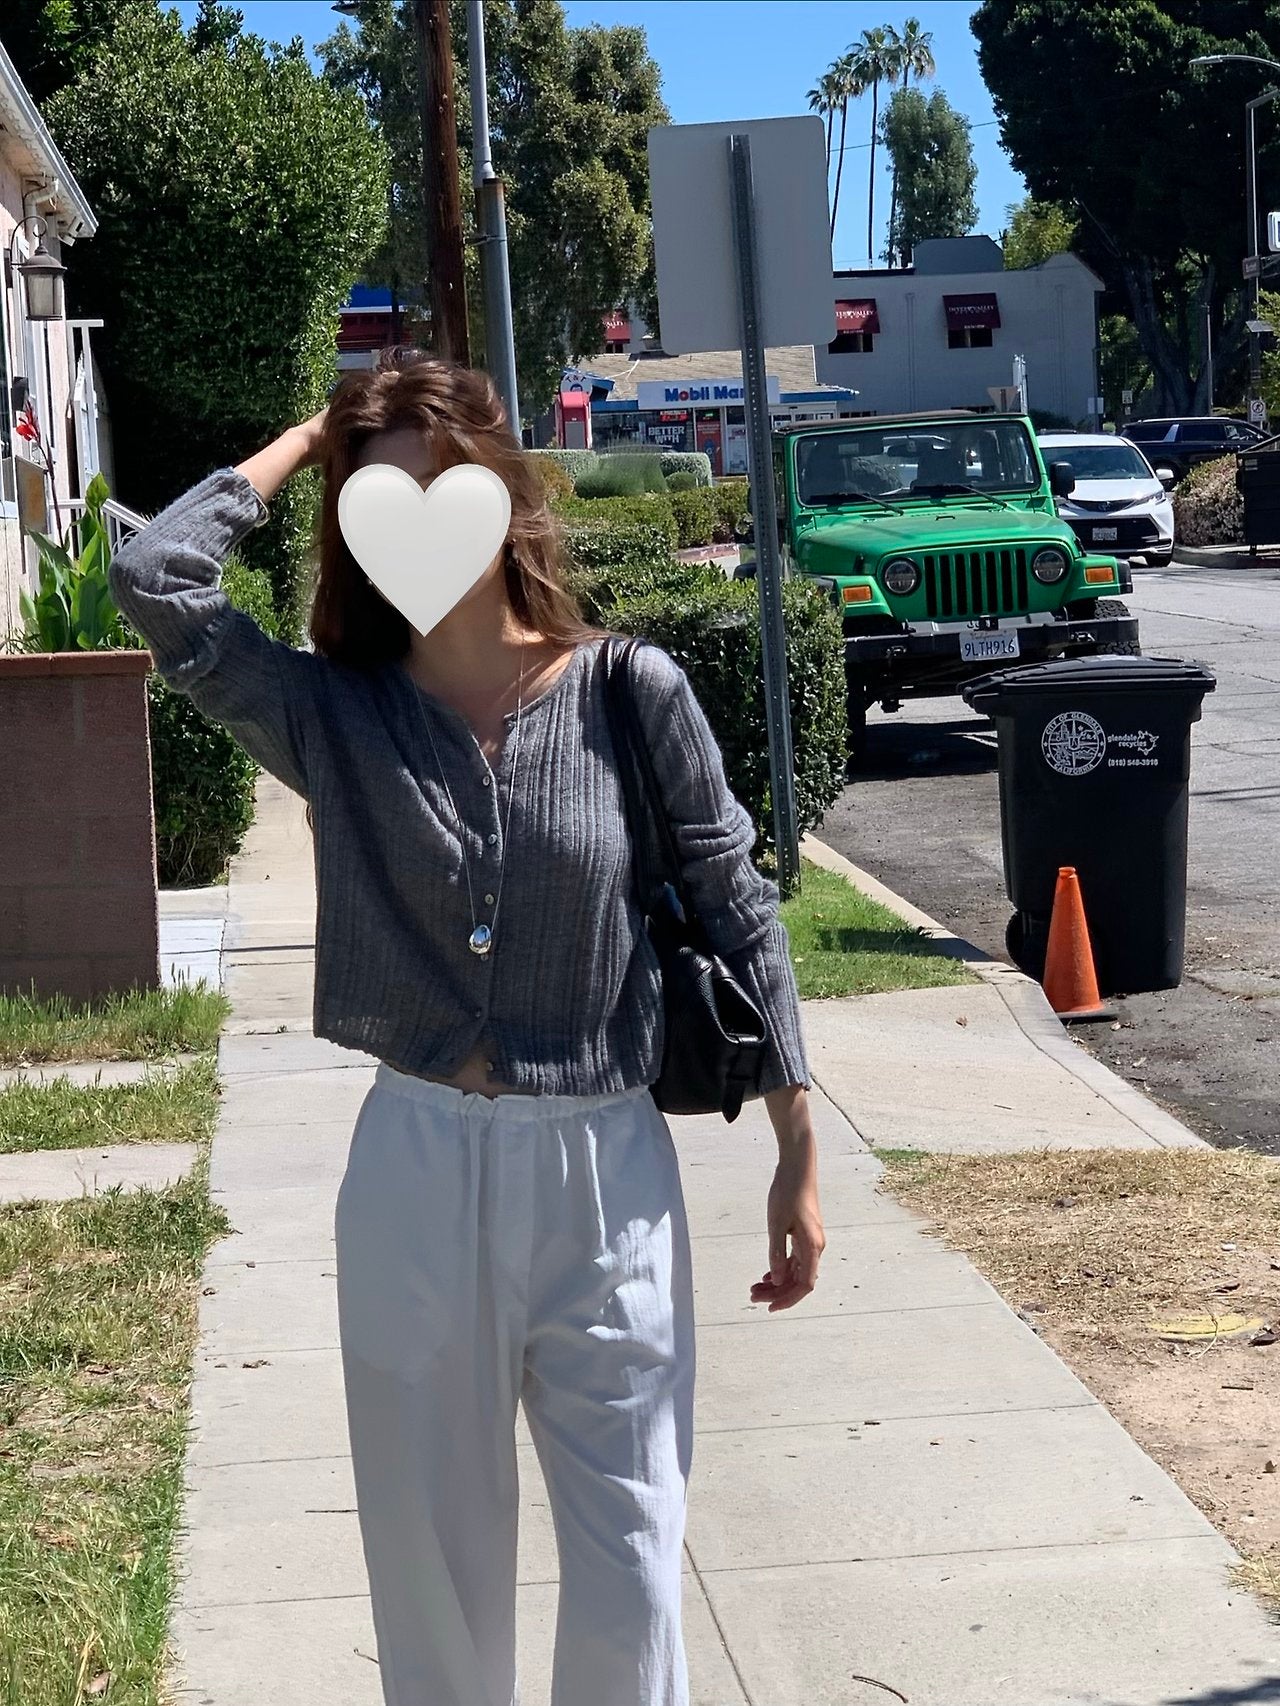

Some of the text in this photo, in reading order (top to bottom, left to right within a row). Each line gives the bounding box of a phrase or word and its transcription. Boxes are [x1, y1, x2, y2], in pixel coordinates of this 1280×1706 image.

[665, 386, 709, 402] Mobil
[648, 425, 685, 436] BETTER
[655, 434, 679, 444] WITH
[964, 639, 1015, 657] 9LTH916
[1045, 713, 1102, 735] CITY OF GLENDALE
[1107, 733, 1138, 743] glendale
[1118, 740, 1147, 748] recycles
[1108, 758, 1126, 767] (818)
[1054, 762, 1094, 776] CALIFORNIA
